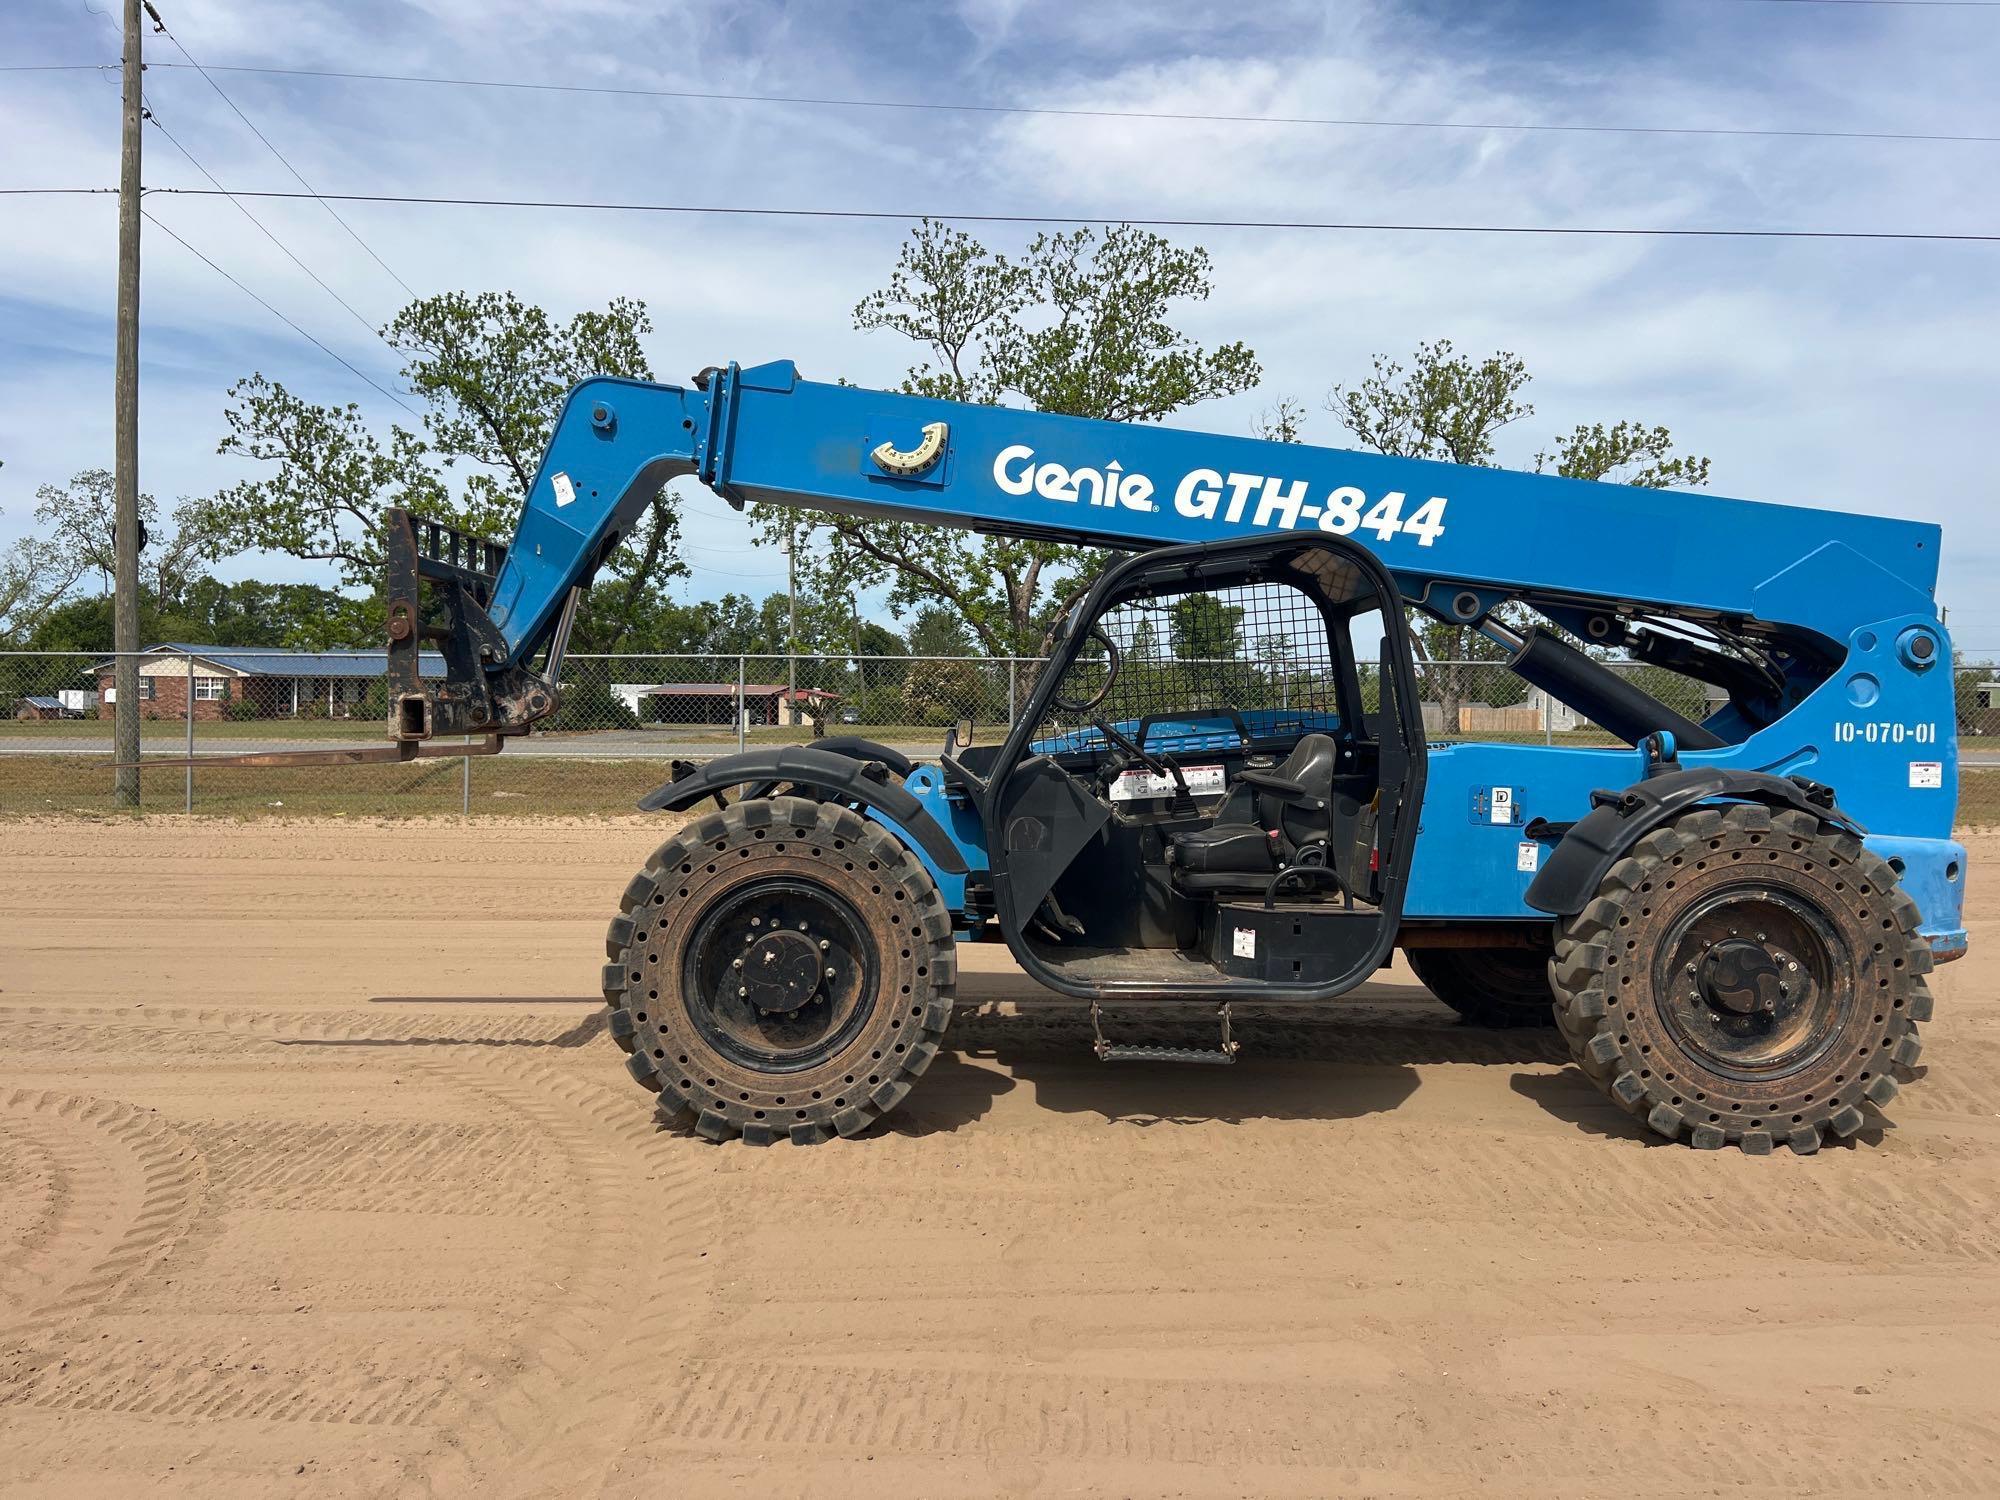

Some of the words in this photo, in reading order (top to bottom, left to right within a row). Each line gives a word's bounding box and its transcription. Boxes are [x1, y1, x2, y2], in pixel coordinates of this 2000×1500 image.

[993, 444, 1155, 512] Genie
[1174, 468, 1448, 547] GTH-844
[1835, 722, 1936, 743] 10-070-01
